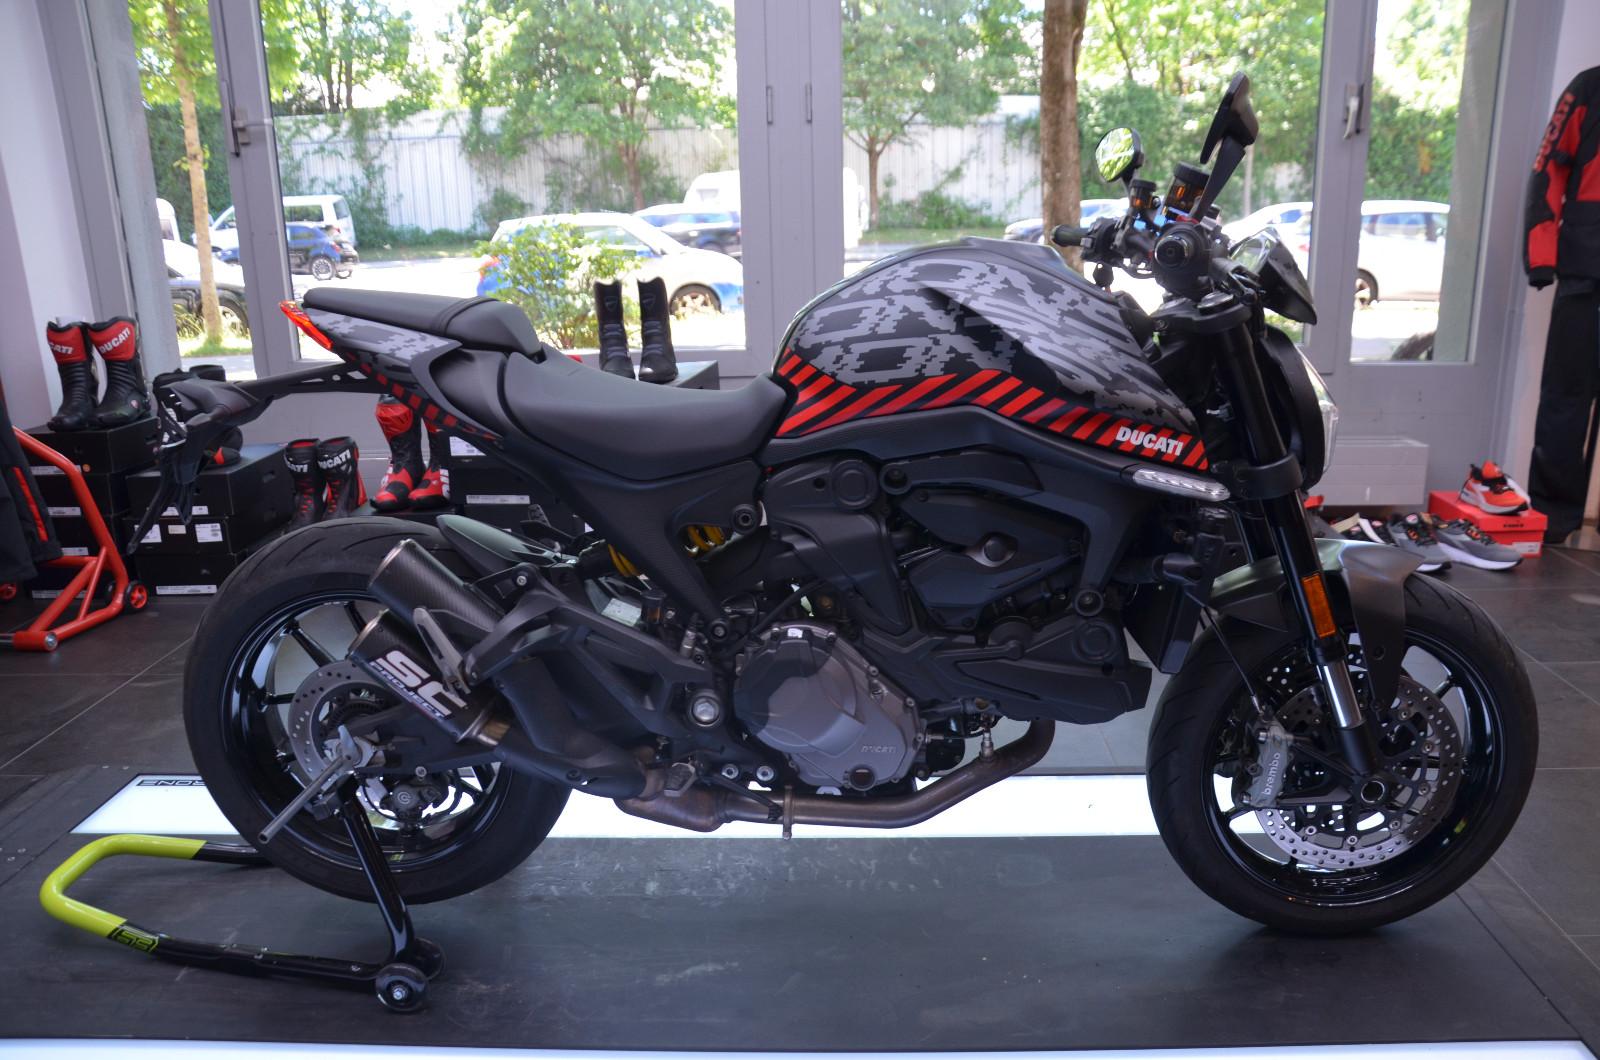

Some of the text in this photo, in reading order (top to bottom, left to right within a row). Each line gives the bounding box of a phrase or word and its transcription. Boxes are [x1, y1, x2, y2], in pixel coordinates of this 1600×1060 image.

[1115, 426, 1184, 456] DUCATI
[368, 660, 446, 718] PROJECT
[860, 744, 897, 753] DUCATI
[1261, 752, 1281, 795] brembo
